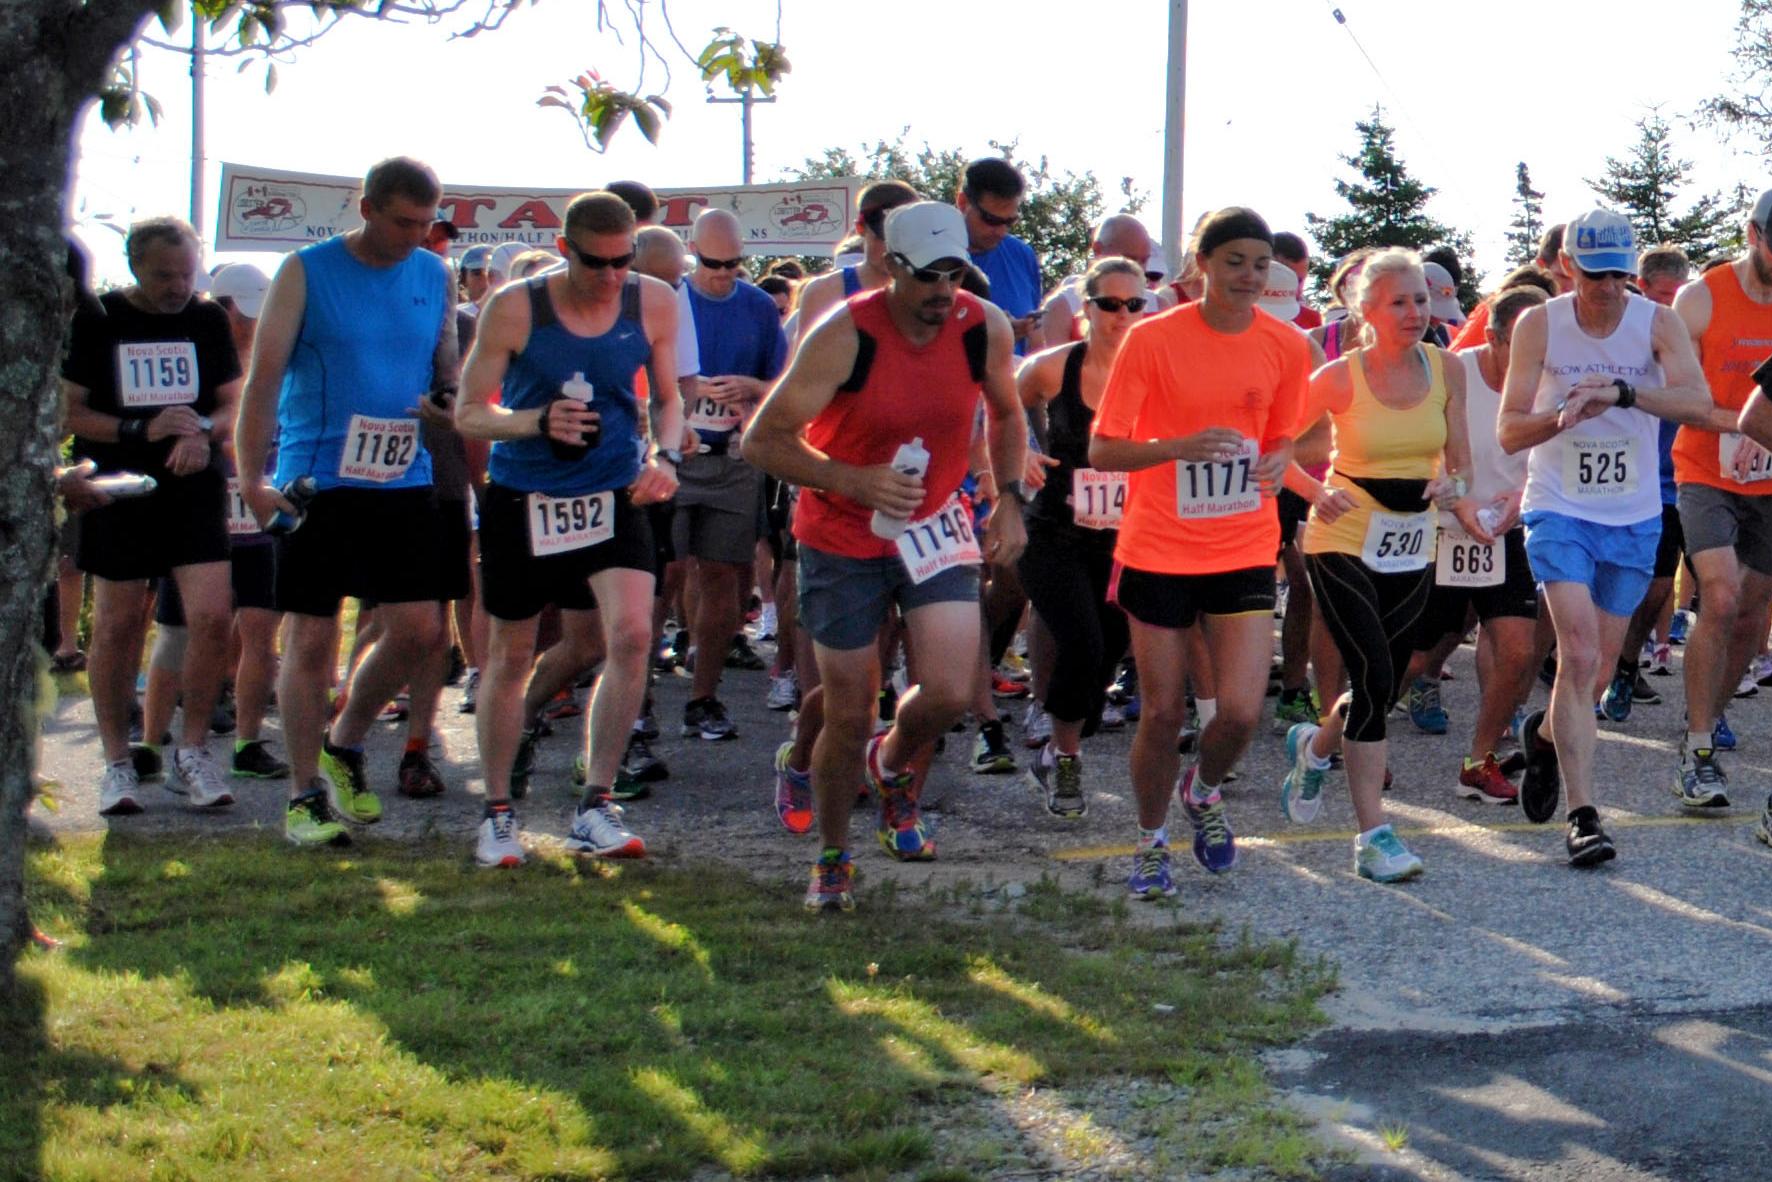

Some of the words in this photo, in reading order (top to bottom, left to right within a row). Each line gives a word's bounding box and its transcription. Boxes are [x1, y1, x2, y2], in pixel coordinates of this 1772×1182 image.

[127, 346, 153, 356] Nova
[156, 345, 188, 355] Scotia
[129, 356, 191, 388] 1159
[359, 419, 386, 431] Nova
[388, 421, 415, 433] Scotia
[356, 432, 413, 466] 1182
[1573, 440, 1597, 449] NOVA
[1599, 440, 1630, 449] SCOTIA
[345, 466, 368, 477] Half
[1082, 471, 1108, 481] Nova
[1186, 458, 1251, 498] 1177
[1579, 450, 1627, 485] 525
[1083, 484, 1126, 515] 114
[1577, 486, 1625, 495] MARATHON
[537, 496, 603, 536] 1592
[1183, 502, 1205, 514] Half
[1207, 499, 1256, 513] Marathon
[903, 507, 972, 558] 1146
[1376, 529, 1424, 558] 530
[915, 560, 939, 578] Half
[1452, 544, 1494, 574] 663
[1450, 575, 1493, 583] MARATHON
